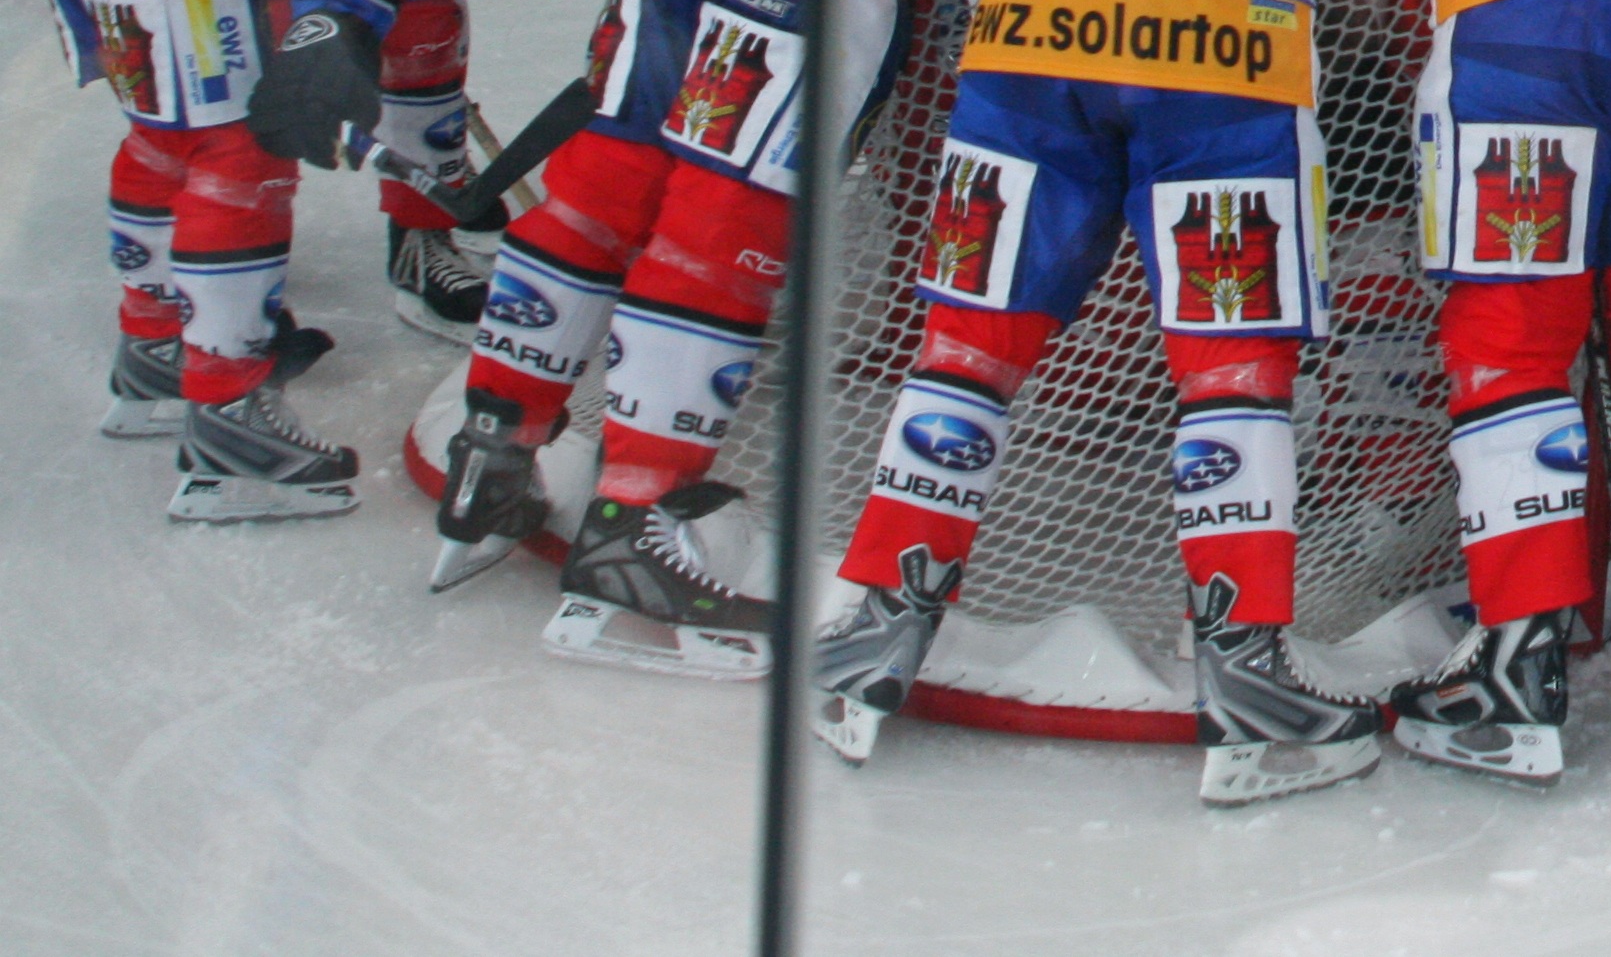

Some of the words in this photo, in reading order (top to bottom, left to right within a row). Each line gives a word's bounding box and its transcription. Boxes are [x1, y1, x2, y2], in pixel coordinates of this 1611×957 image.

[969, 2, 1273, 82] ewz.solartop
[1252, 8, 1287, 26] star
[216, 15, 248, 74] ewz
[874, 465, 986, 514] SUBAR
